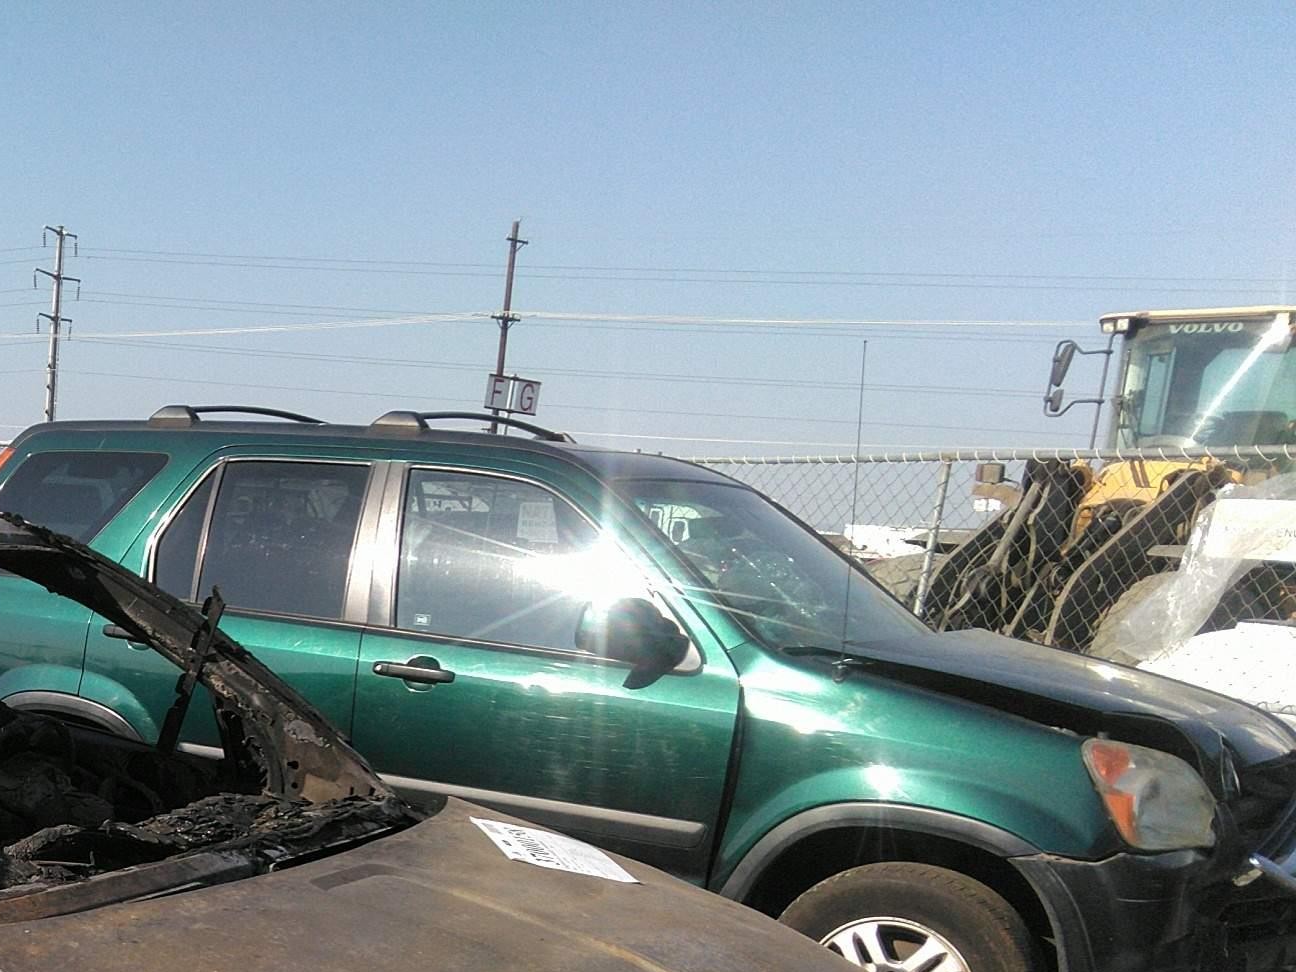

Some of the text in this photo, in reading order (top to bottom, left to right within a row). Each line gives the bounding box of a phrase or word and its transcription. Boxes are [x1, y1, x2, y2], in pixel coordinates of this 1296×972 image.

[1168, 321, 1244, 335] VOLVO
[490, 377, 505, 406] F
[519, 383, 535, 412] G
